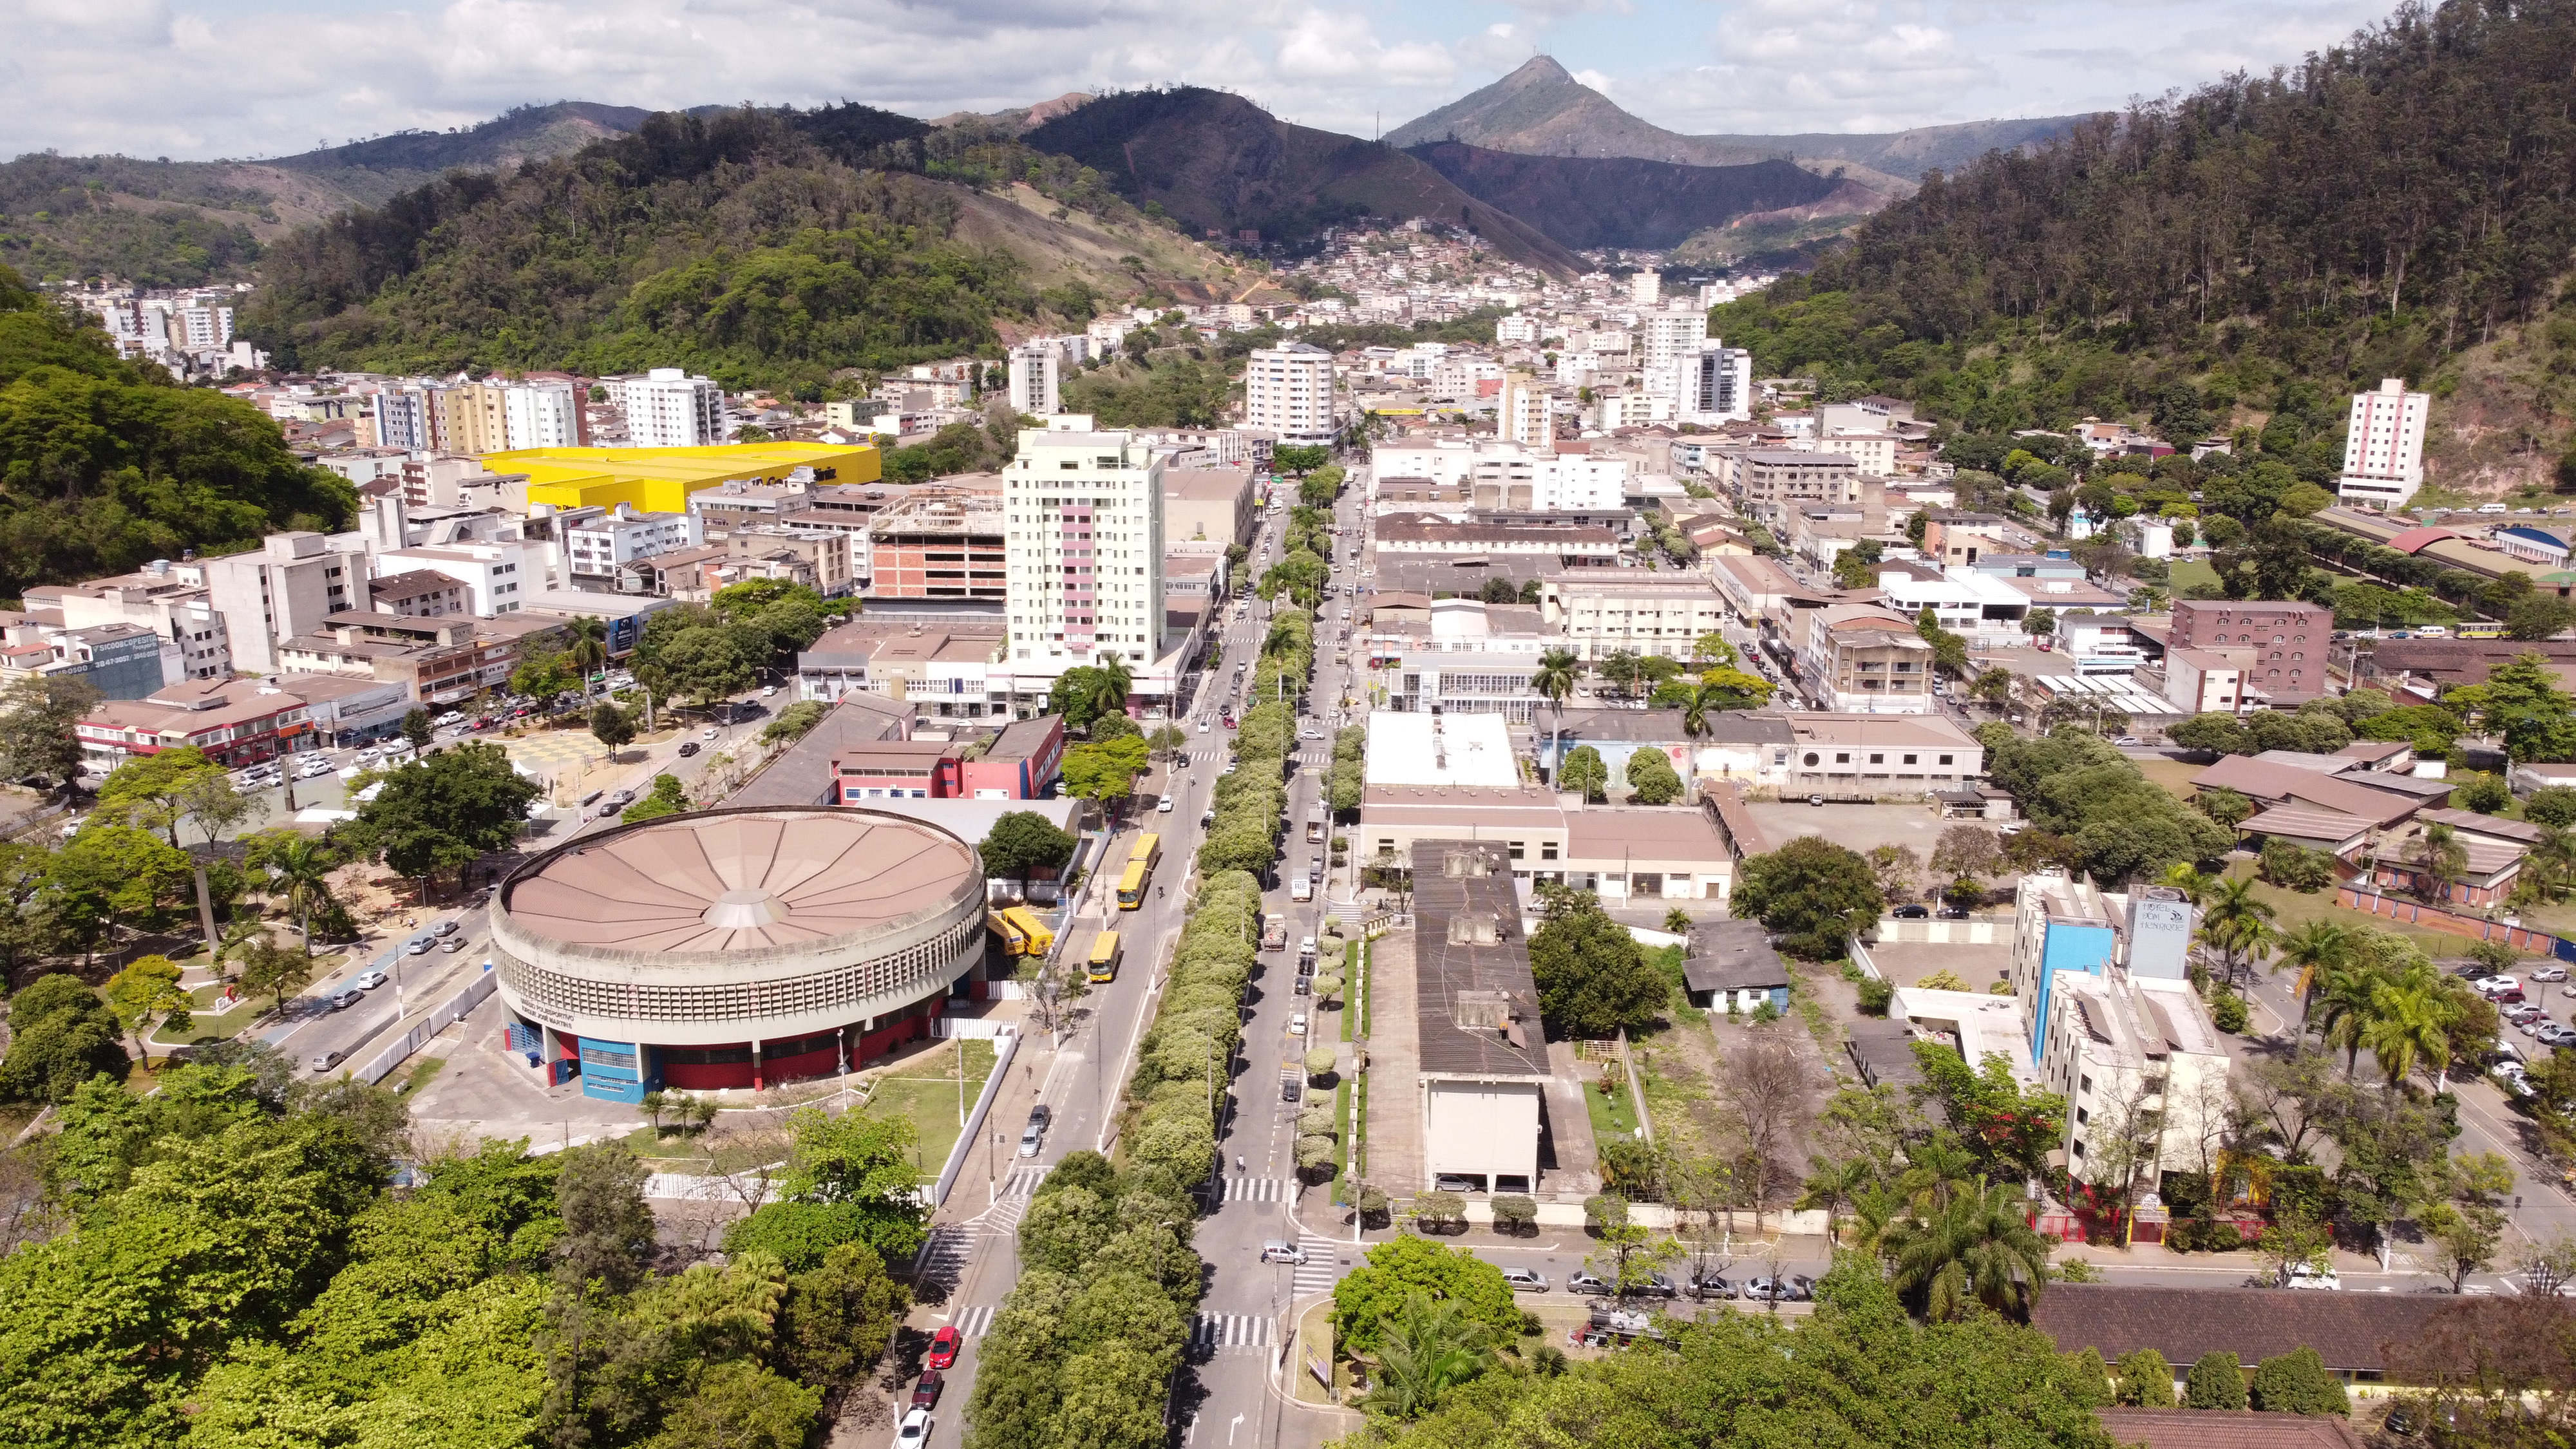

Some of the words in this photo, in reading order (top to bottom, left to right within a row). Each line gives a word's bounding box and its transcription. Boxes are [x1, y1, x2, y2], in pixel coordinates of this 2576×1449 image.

[2143, 903, 2171, 913] HOTEL
[2143, 913, 2160, 921] DOM
[2140, 921, 2184, 932] HENRIQUE
[549, 1017, 573, 1029] MARTINS
